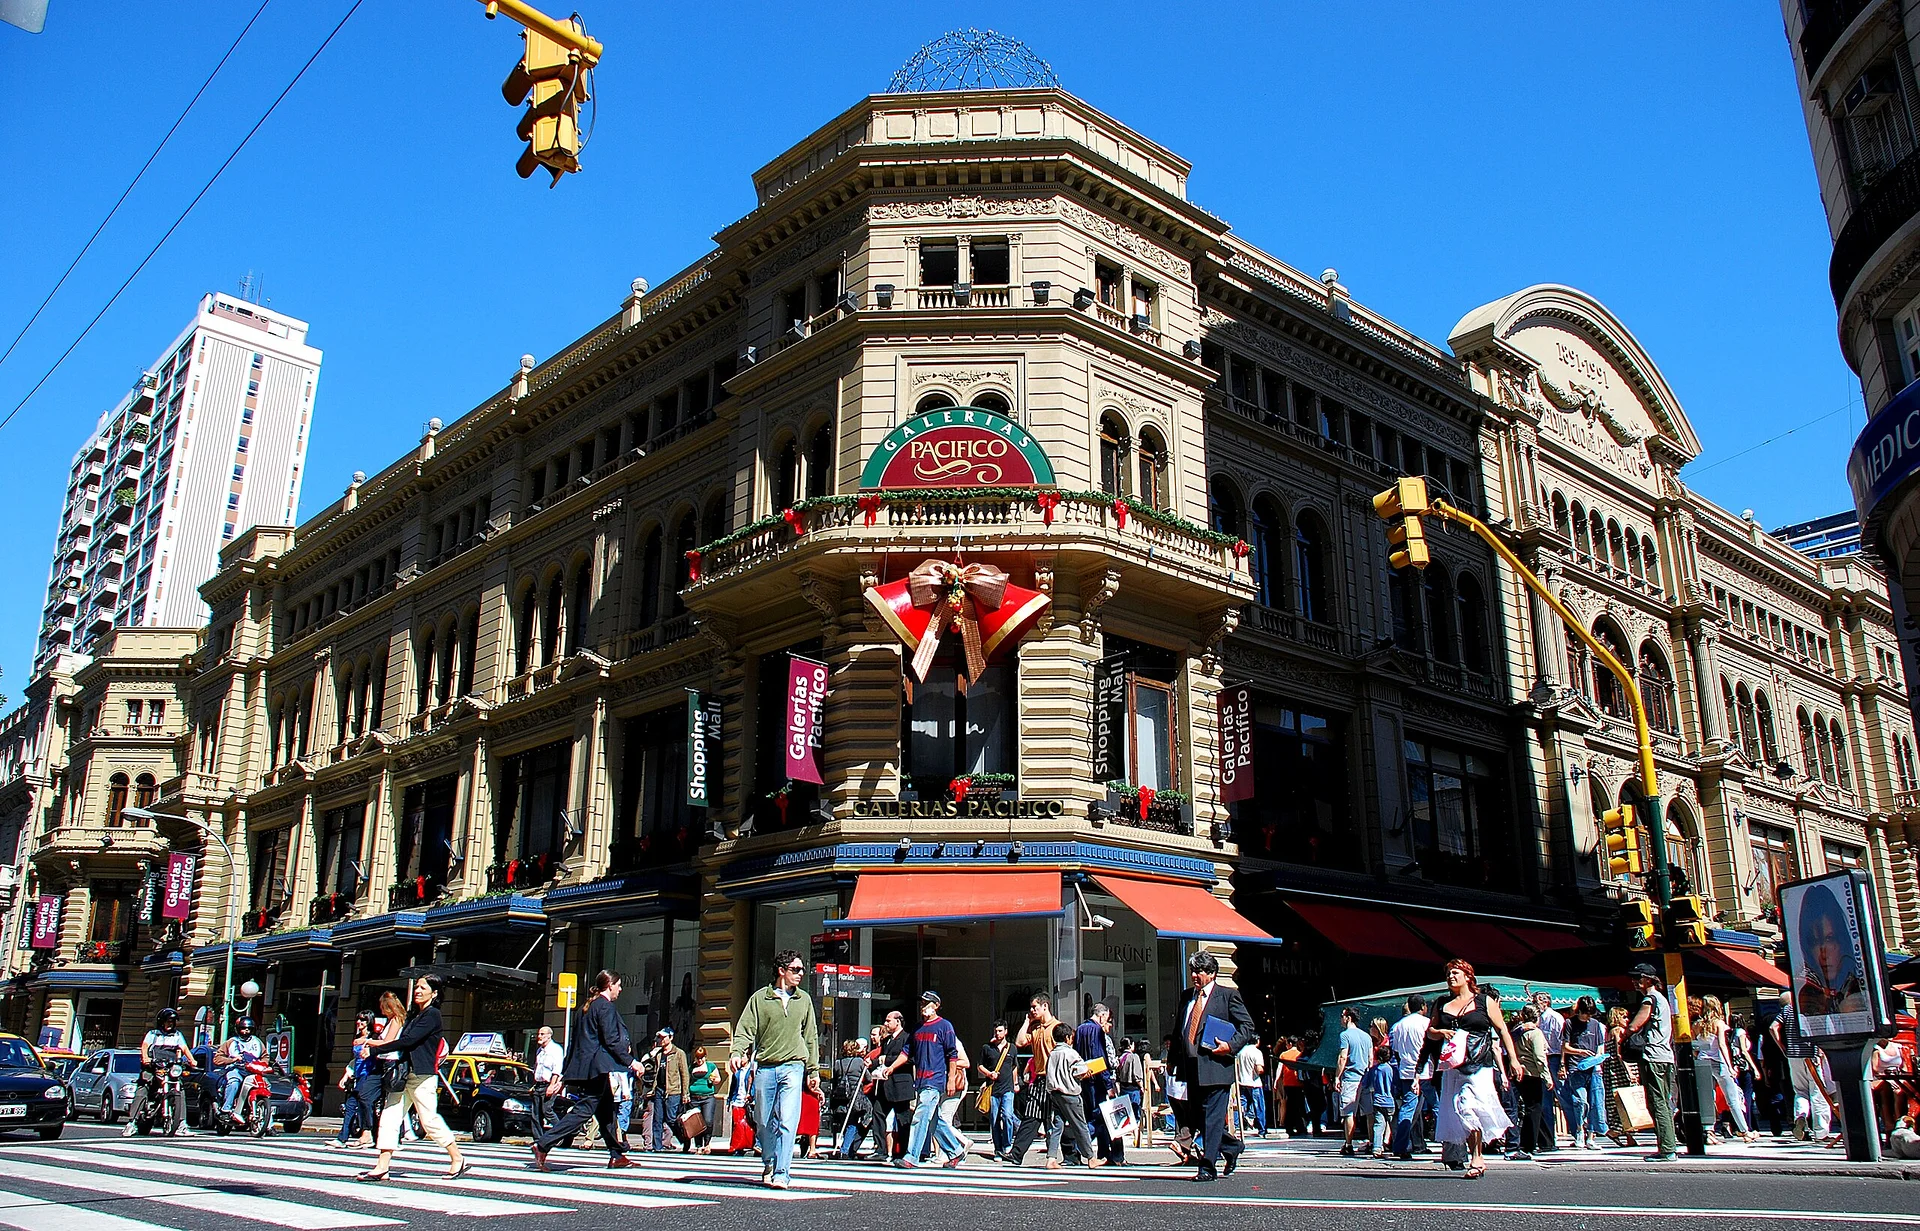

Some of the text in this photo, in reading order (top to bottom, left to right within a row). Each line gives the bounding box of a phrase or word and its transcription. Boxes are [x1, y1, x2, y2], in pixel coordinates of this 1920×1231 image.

[884, 411, 1032, 451] GALERIAS
[911, 439, 1007, 459] PACIFICO
[1111, 660, 1124, 702] Mall
[708, 701, 721, 740] Mall
[789, 675, 808, 760] Galerías
[807, 668, 826, 748] Pacífico
[1095, 677, 1111, 775] Shopping
[1236, 690, 1250, 767] Pacífico
[689, 709, 708, 800] Shopping
[1221, 705, 1236, 785] Galerías
[853, 800, 1064, 817] GALERIAS PACIFICO
[140, 871, 159, 920] Shopping
[179, 857, 194, 900] Pacífico
[20, 907, 35, 948] Shopping
[1843, 881, 1859, 939] giordano
